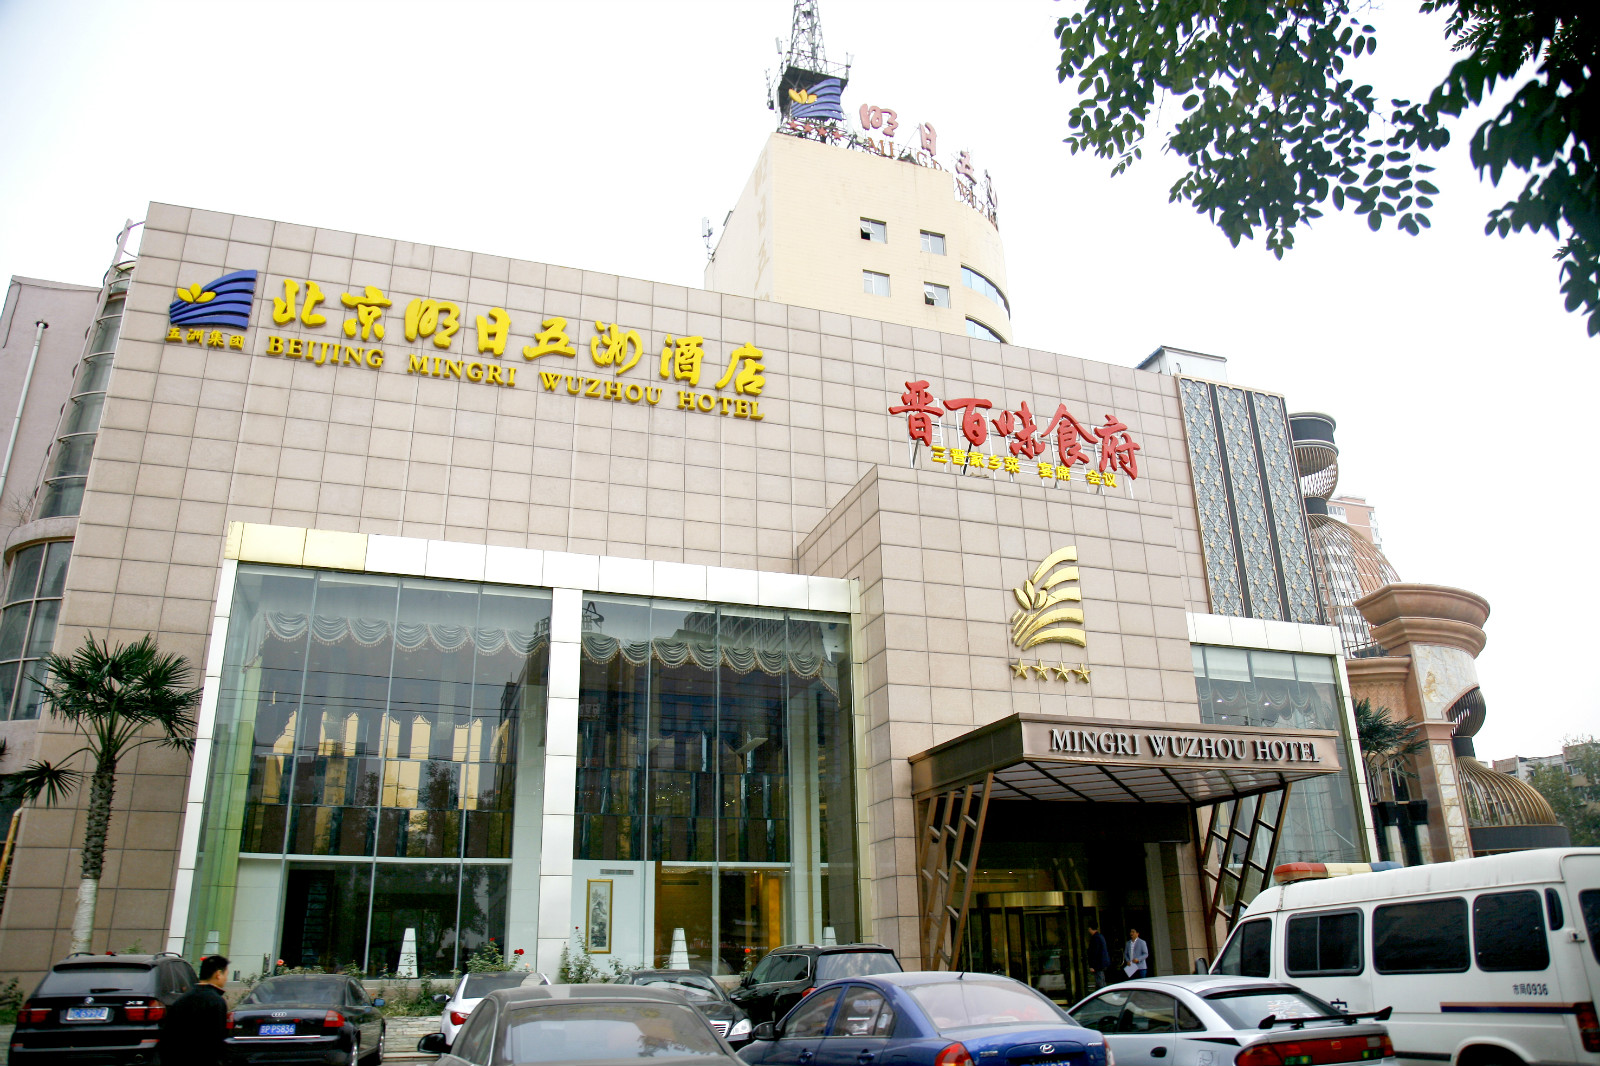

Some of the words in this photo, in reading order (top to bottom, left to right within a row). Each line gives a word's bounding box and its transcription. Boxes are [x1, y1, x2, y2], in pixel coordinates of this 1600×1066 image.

[165, 327, 246, 351] 五洲集团
[272, 279, 766, 397] 北京明日五洲酒店
[265, 335, 385, 369] BEIJING
[407, 353, 517, 387] MINGRI
[539, 372, 663, 406] WUZHOU
[677, 390, 766, 421] HOTEL
[888, 380, 1141, 480] 晋百味食府
[931, 445, 1020, 474] 三晋家乡菜
[1037, 462, 1071, 482] 宴席
[1085, 469, 1118, 488] 会议
[1051, 727, 1142, 756] MINGRI
[1148, 733, 1247, 760] WUZHOU
[1253, 740, 1323, 764] HOTEL
